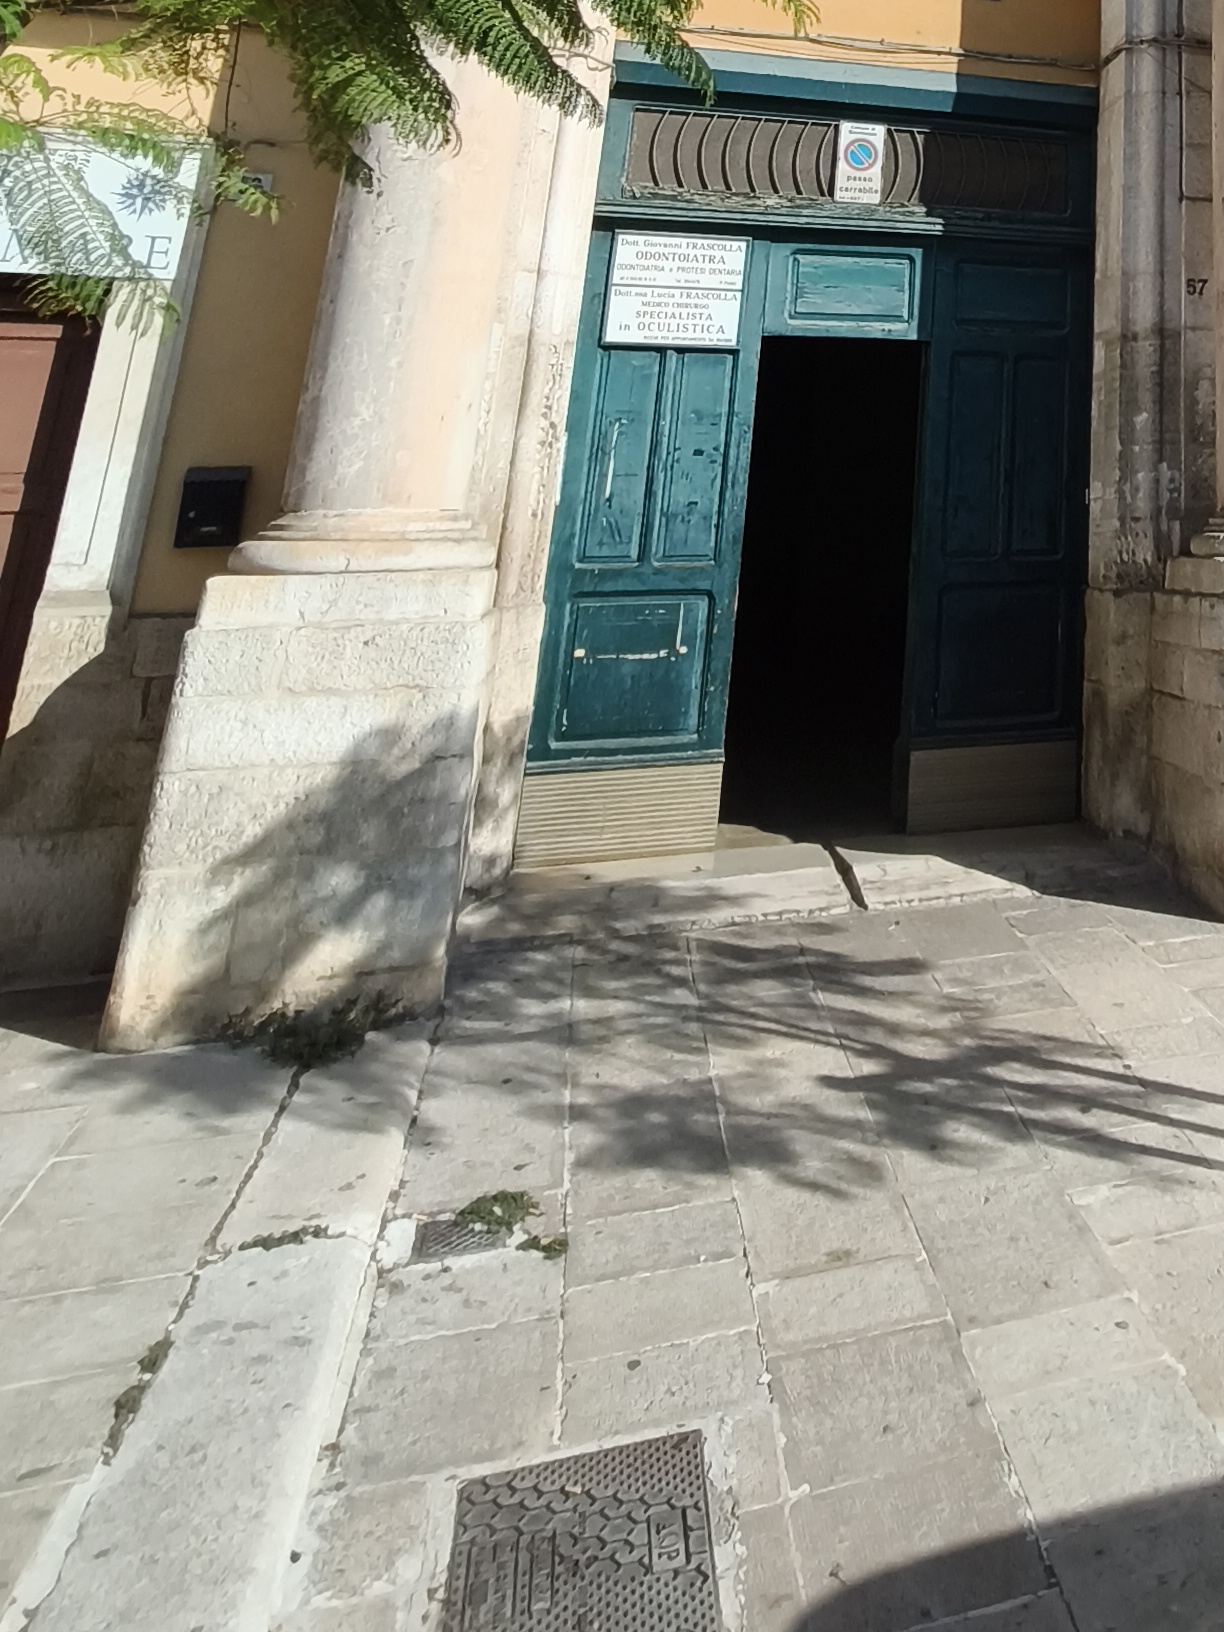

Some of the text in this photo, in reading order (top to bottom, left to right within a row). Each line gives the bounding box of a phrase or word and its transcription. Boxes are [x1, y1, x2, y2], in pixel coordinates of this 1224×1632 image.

[846, 175, 873, 183] passo
[839, 186, 879, 195] carrabile
[643, 239, 683, 249] Giovanni
[686, 242, 743, 253] FRASCOLLA
[635, 251, 726, 265] ODONTOIATRA
[616, 263, 665, 273] ODONTOIATRIA
[676, 266, 707, 275] PROTESI
[708, 268, 742, 276] DENTARIA
[1186, 278, 1208, 296] 57
[651, 290, 675, 299] Lucia
[679, 291, 738, 301] FRASCOLLA
[641, 300, 710, 310] MEDICO CHIRURGO
[635, 310, 713, 321] SPECIALISTA
[618, 321, 726, 335] in OCULISTICA
